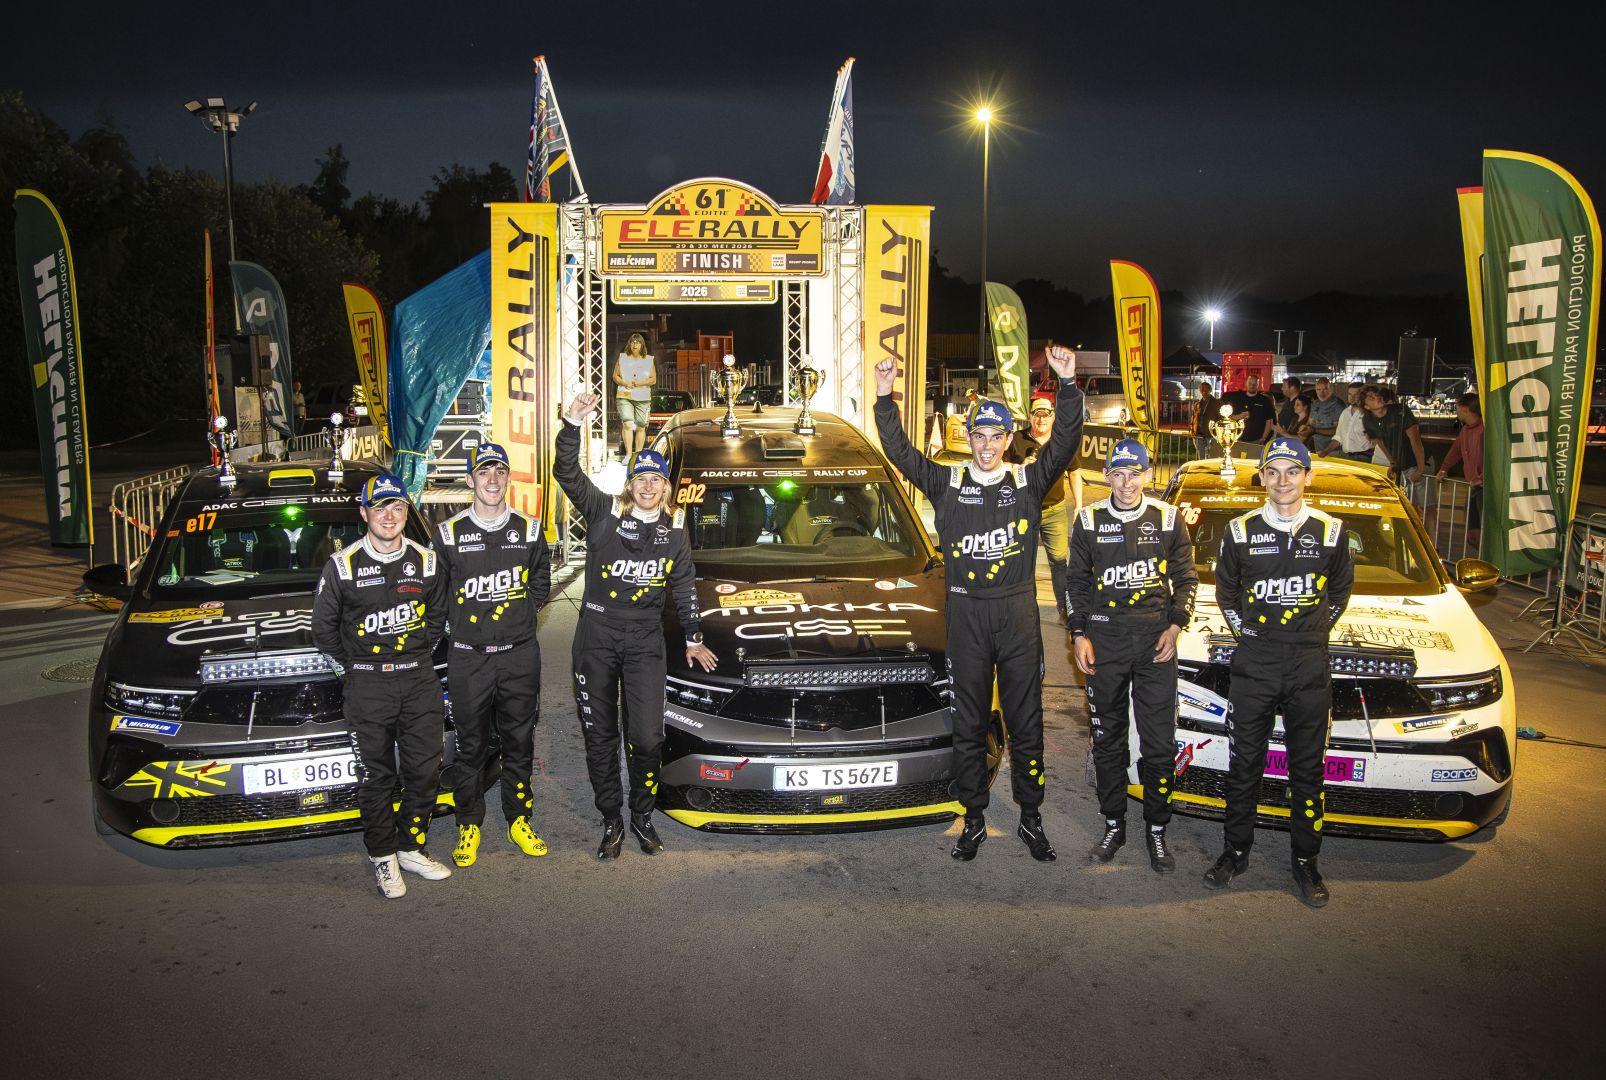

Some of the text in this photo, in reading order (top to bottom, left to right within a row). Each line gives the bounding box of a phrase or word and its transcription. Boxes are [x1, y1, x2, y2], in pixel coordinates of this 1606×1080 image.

[619, 219, 811, 243] ELERALLY
[609, 255, 655, 266] HELICHEM
[682, 253, 742, 269] FINISH
[681, 286, 708, 297] 2026
[676, 484, 706, 504] e02
[960, 486, 982, 495] ADAC
[202, 503, 238, 512] ADAC
[312, 496, 352, 504] RALLY
[186, 512, 217, 533] e17
[1098, 523, 1122, 533] ADAC
[459, 533, 482, 543] ADAC
[961, 521, 1016, 555] OMG!
[1250, 533, 1277, 544] ADAC
[357, 565, 382, 578] ADAC
[611, 558, 666, 577] OMG!
[1103, 557, 1158, 586] OMG!
[464, 566, 522, 599] OMG!
[1115, 575, 1160, 589] GSE
[1254, 572, 1316, 600] OMG!
[476, 586, 524, 602] GSE
[1265, 593, 1317, 606] GSE
[364, 600, 418, 633] OMG!
[700, 602, 938, 618] MOKKA
[378, 617, 421, 635] GSE
[734, 619, 912, 640] GSE
[578, 674, 594, 729] OPEL
[128, 721, 170, 731] MICHELIN
[664, 710, 704, 729] MICHELIN
[1327, 761, 1346, 776] CR
[1353, 772, 1363, 780] 52
[1433, 768, 1477, 780] sparco
[265, 768, 289, 787] BL
[786, 770, 808, 787] KS
